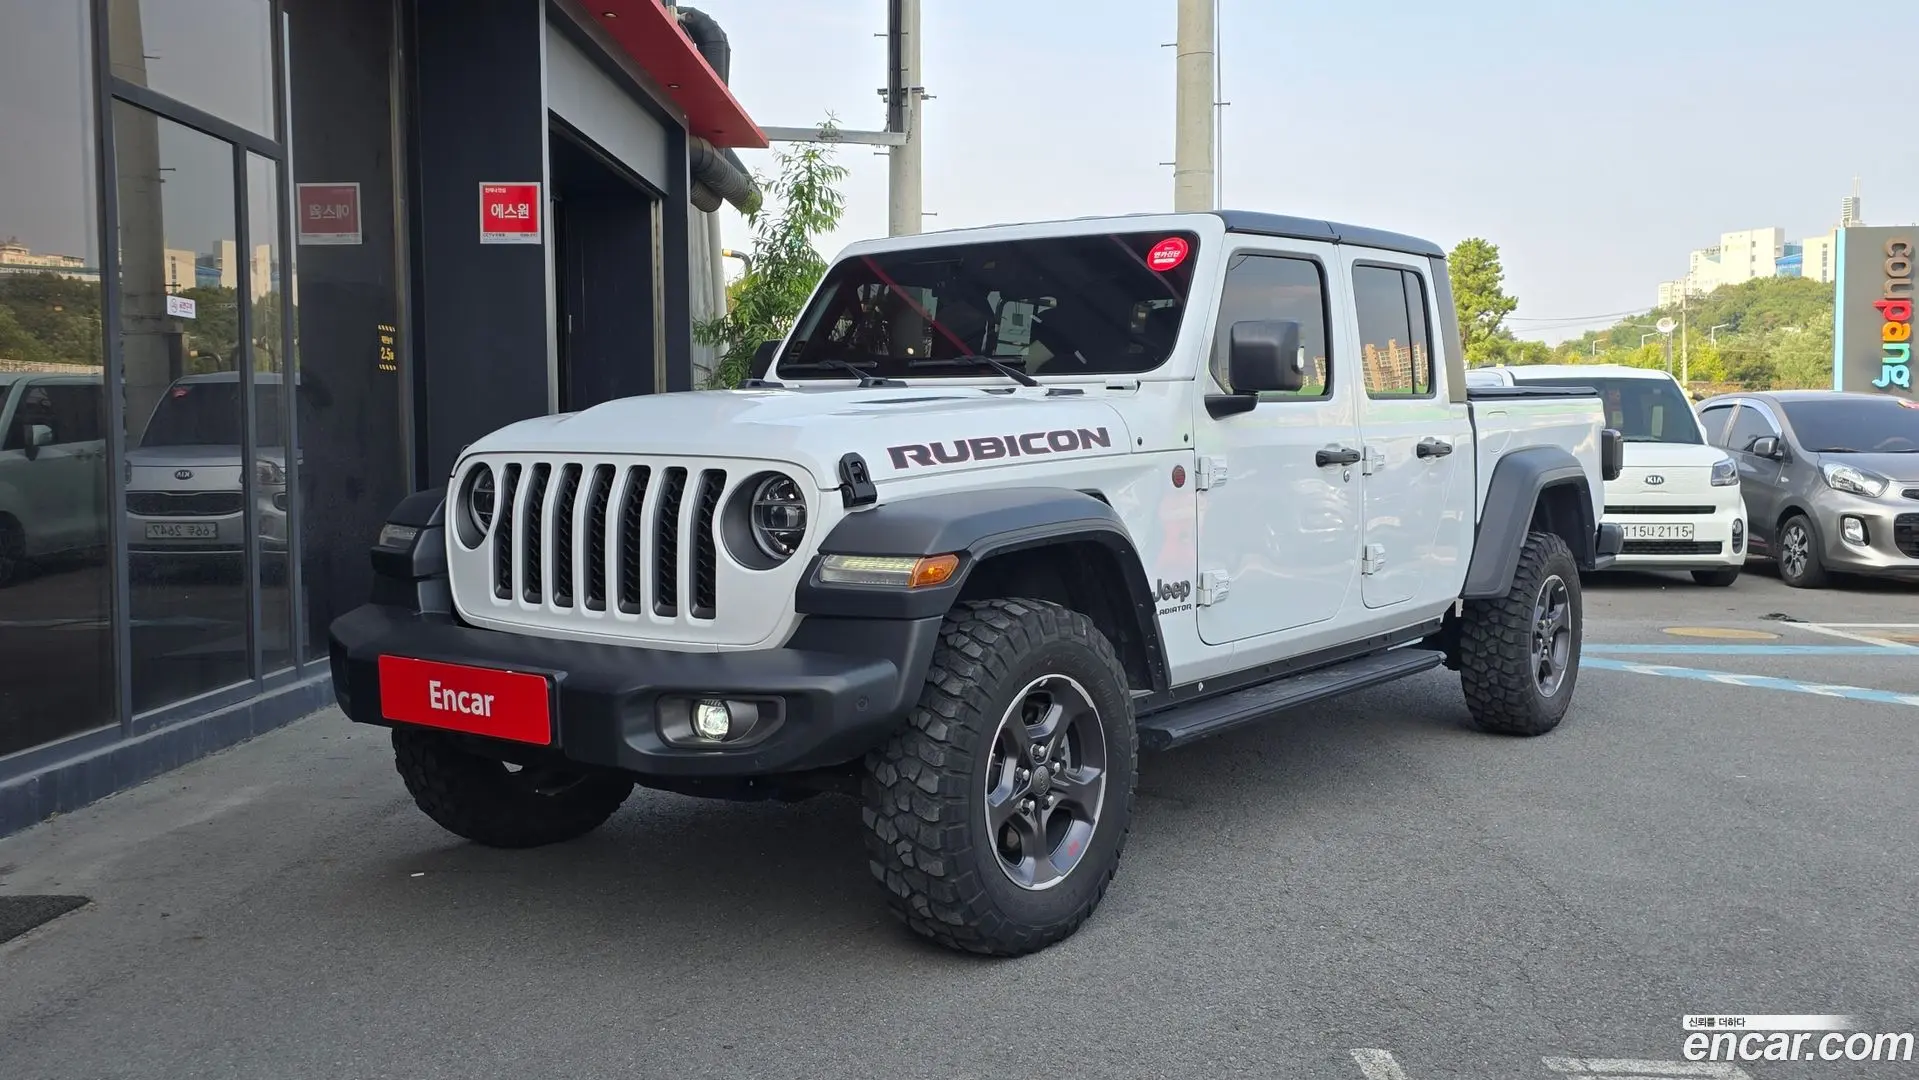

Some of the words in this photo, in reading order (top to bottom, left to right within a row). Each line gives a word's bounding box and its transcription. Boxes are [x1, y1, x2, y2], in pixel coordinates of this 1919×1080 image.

[490, 203, 530, 219] 에스원
[1872, 237, 1912, 388] coupang
[886, 426, 1112, 470] RUBICON
[1647, 476, 1662, 484] KIA
[1658, 525, 1689, 538] 2115
[1152, 578, 1191, 603] Jeep
[429, 680, 494, 717] Encar
